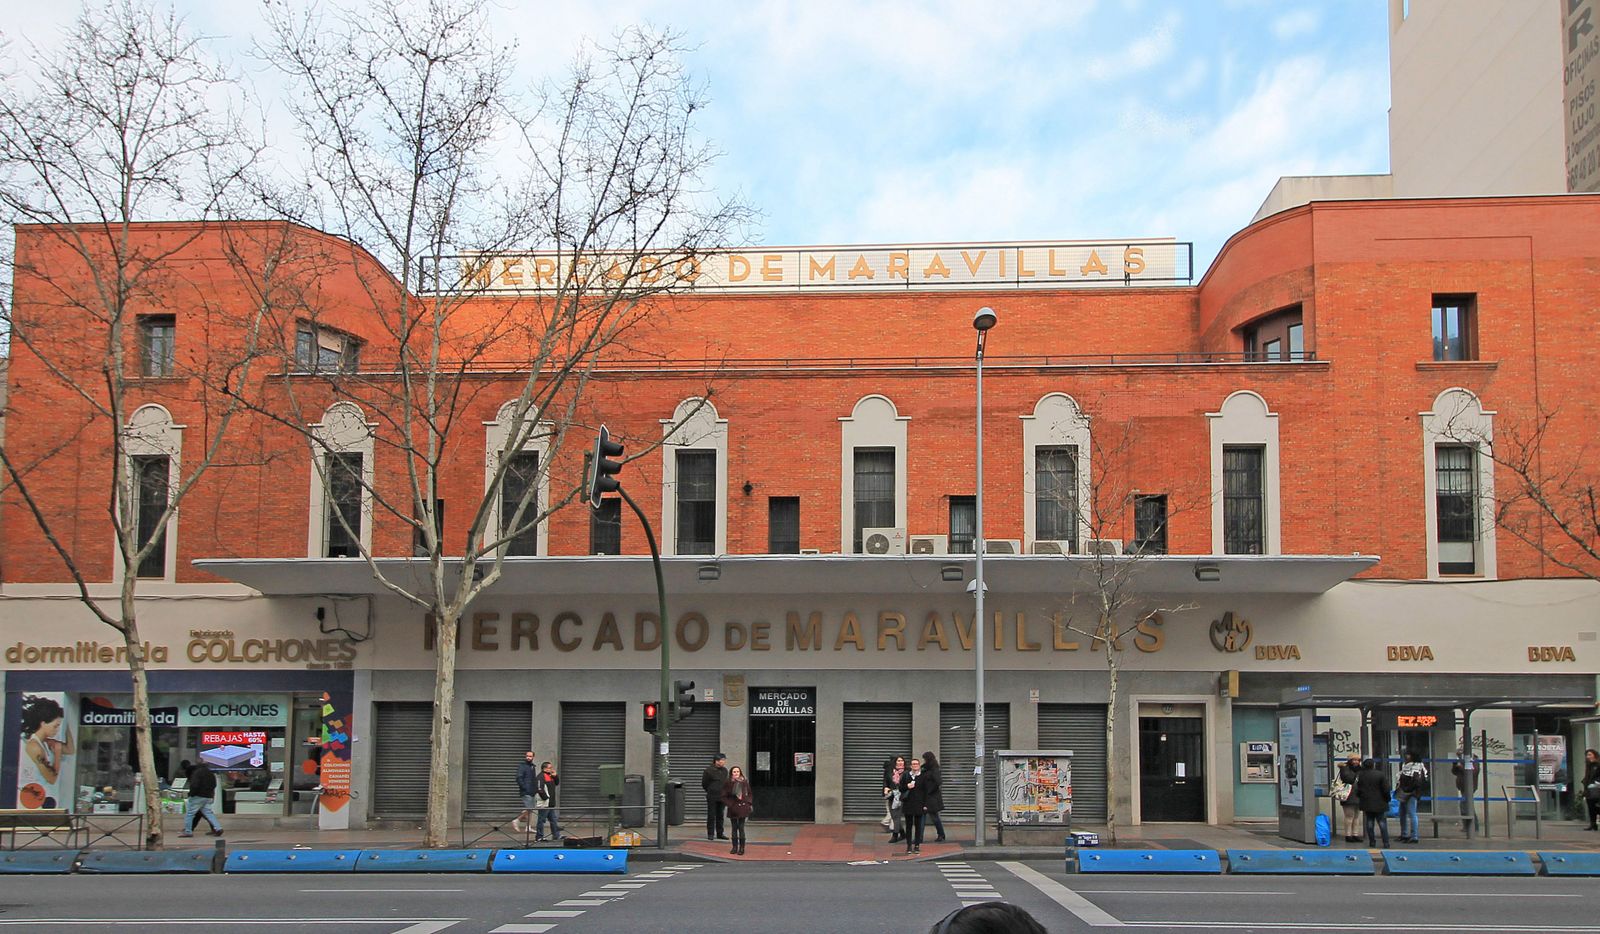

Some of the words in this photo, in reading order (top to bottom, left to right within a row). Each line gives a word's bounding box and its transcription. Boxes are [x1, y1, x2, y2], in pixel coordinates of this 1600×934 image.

[1563, 35, 1600, 86] OFICINAS
[1569, 79, 1596, 116] PISOS
[1572, 103, 1596, 135] LUJO
[728, 254, 784, 282] DE
[808, 247, 1147, 281] MARAVILLAS
[724, 622, 771, 651] DE
[785, 610, 1166, 653] MARAVILLAS
[187, 639, 357, 663] COLCHONES
[1255, 645, 1301, 661] BBVA
[1387, 645, 1434, 661] BBVA
[1528, 646, 1576, 662] BBVA
[759, 692, 807, 700] MERCADO
[83, 712, 175, 724] dormitinda
[188, 704, 279, 717] COLCHONES
[204, 734, 243, 743] REBAJAS
